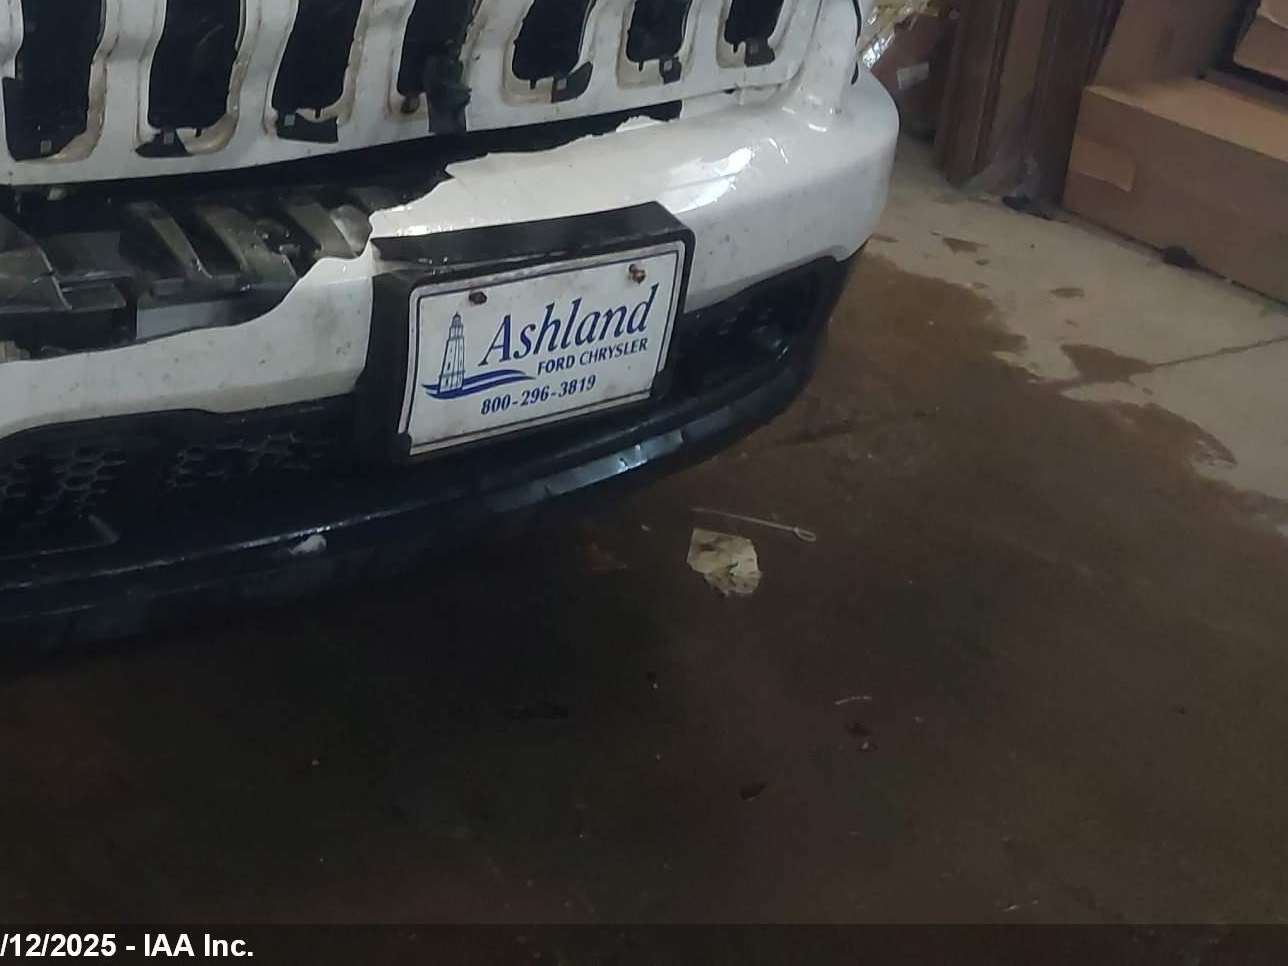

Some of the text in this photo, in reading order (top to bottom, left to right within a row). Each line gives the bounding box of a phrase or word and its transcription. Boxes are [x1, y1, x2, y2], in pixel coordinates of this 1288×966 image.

[478, 283, 660, 367] Ashland
[537, 337, 649, 376] FORD CHRYSLER
[480, 374, 597, 415] 800-296-3819
